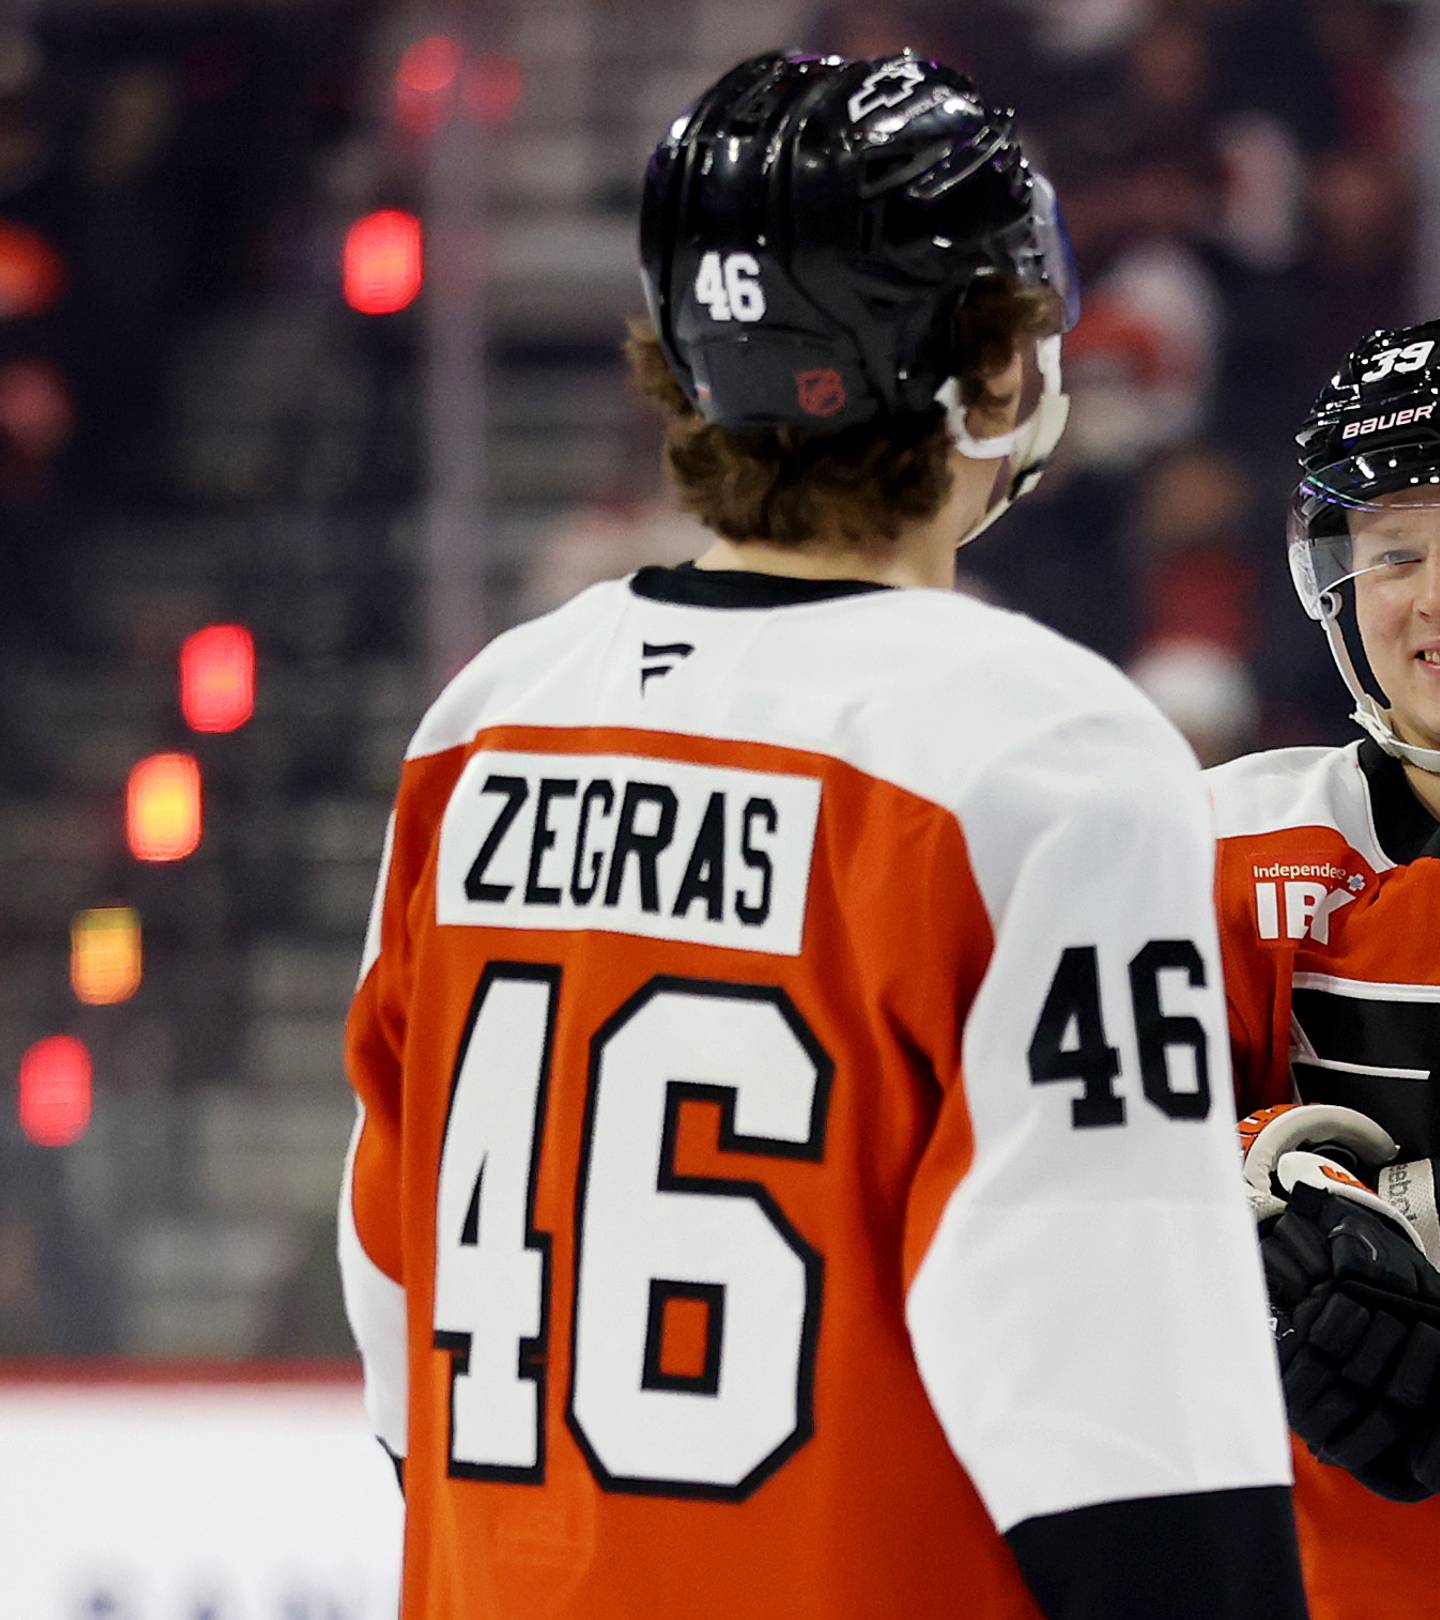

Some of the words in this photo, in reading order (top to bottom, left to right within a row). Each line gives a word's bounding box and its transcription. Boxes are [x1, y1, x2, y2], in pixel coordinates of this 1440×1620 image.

[694, 250, 767, 323] 46
[1361, 340, 1435, 383] 39
[1342, 403, 1435, 440] BAUER
[464, 774, 778, 927] ZEGRAS
[1027, 939, 1212, 1130] 46
[433, 960, 836, 1505] 46
